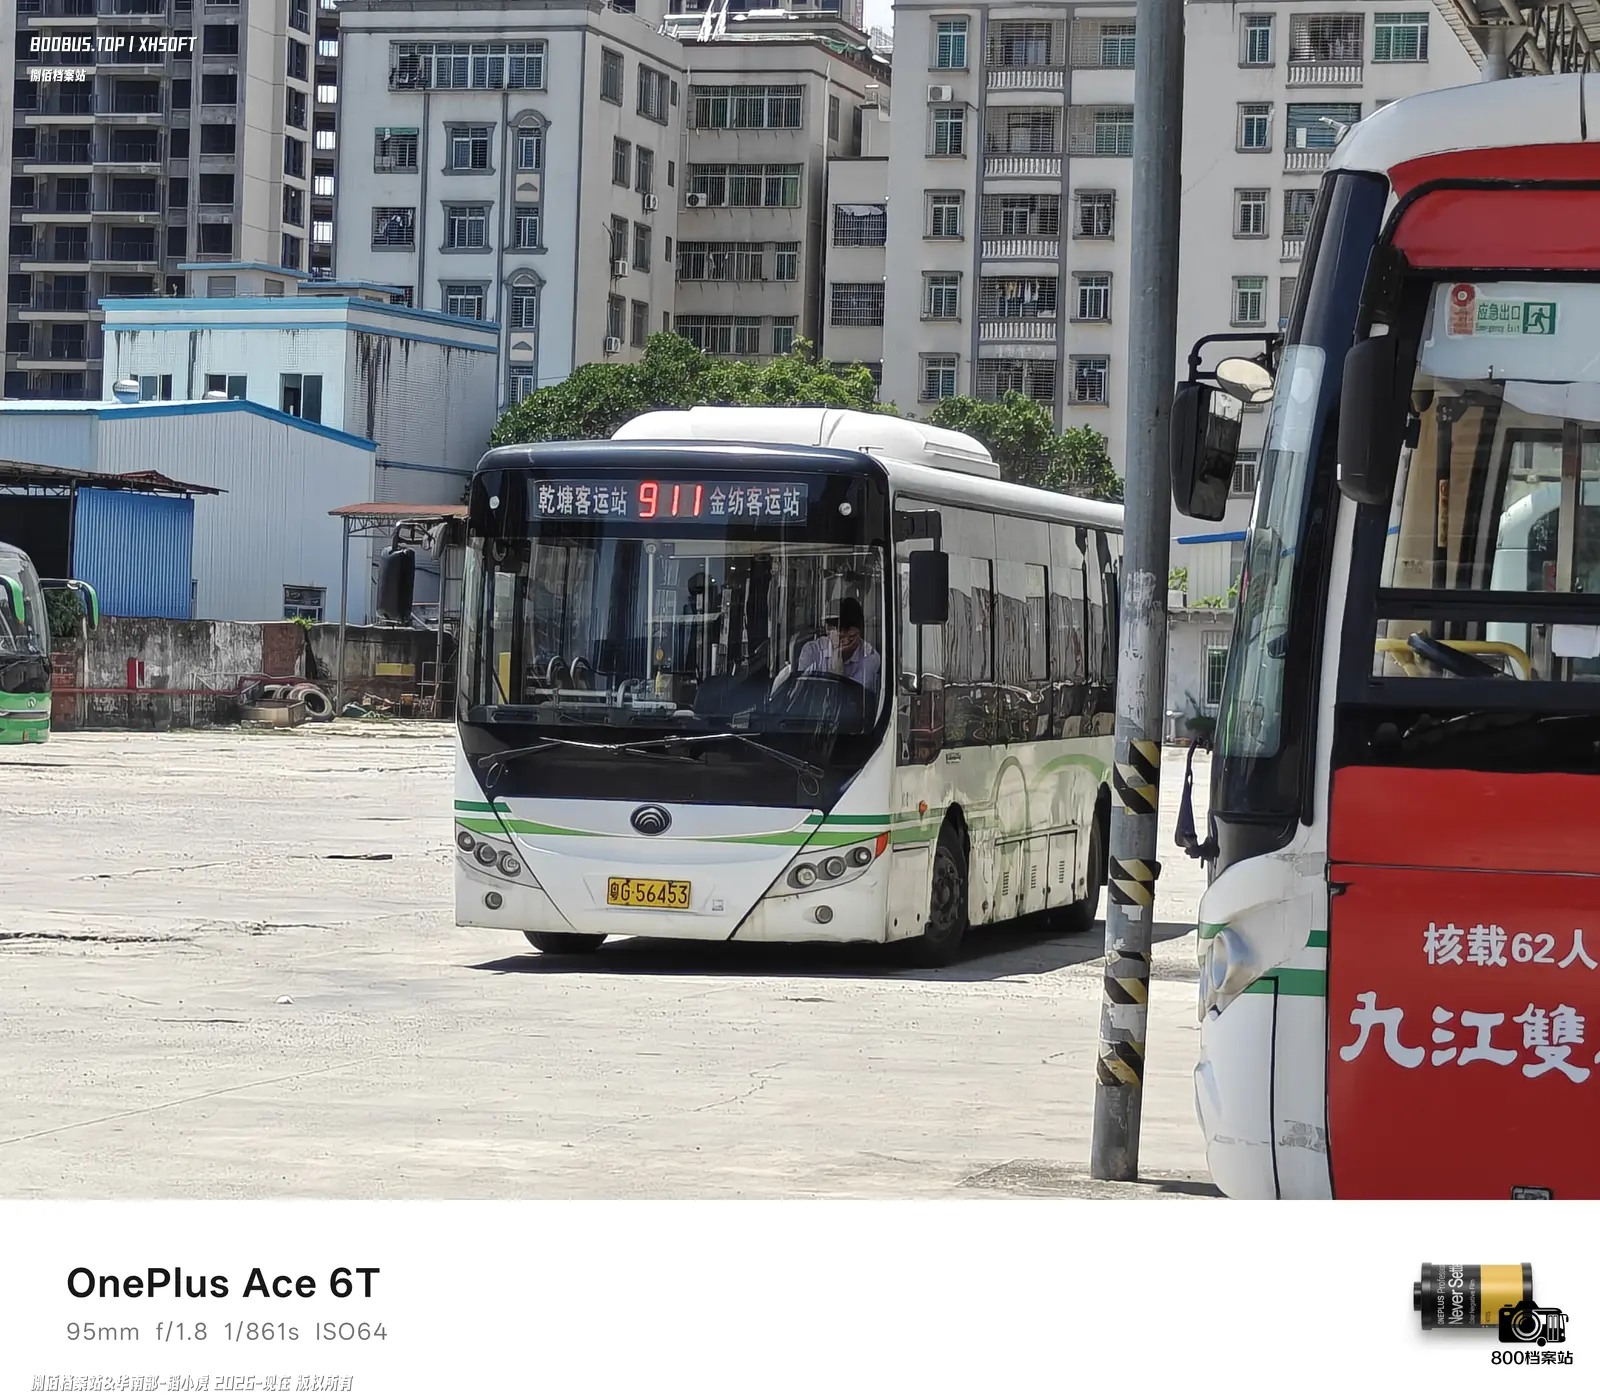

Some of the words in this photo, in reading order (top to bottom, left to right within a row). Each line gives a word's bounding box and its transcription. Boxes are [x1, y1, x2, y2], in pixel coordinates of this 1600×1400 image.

[1477, 302, 1521, 321] 应急出口
[538, 484, 628, 516] 乾塘客运站
[637, 480, 703, 519] 911
[709, 484, 801, 517] 金纺客运站
[1423, 922, 1599, 970] 核载62人
[1339, 991, 1600, 1084] 九江雙
